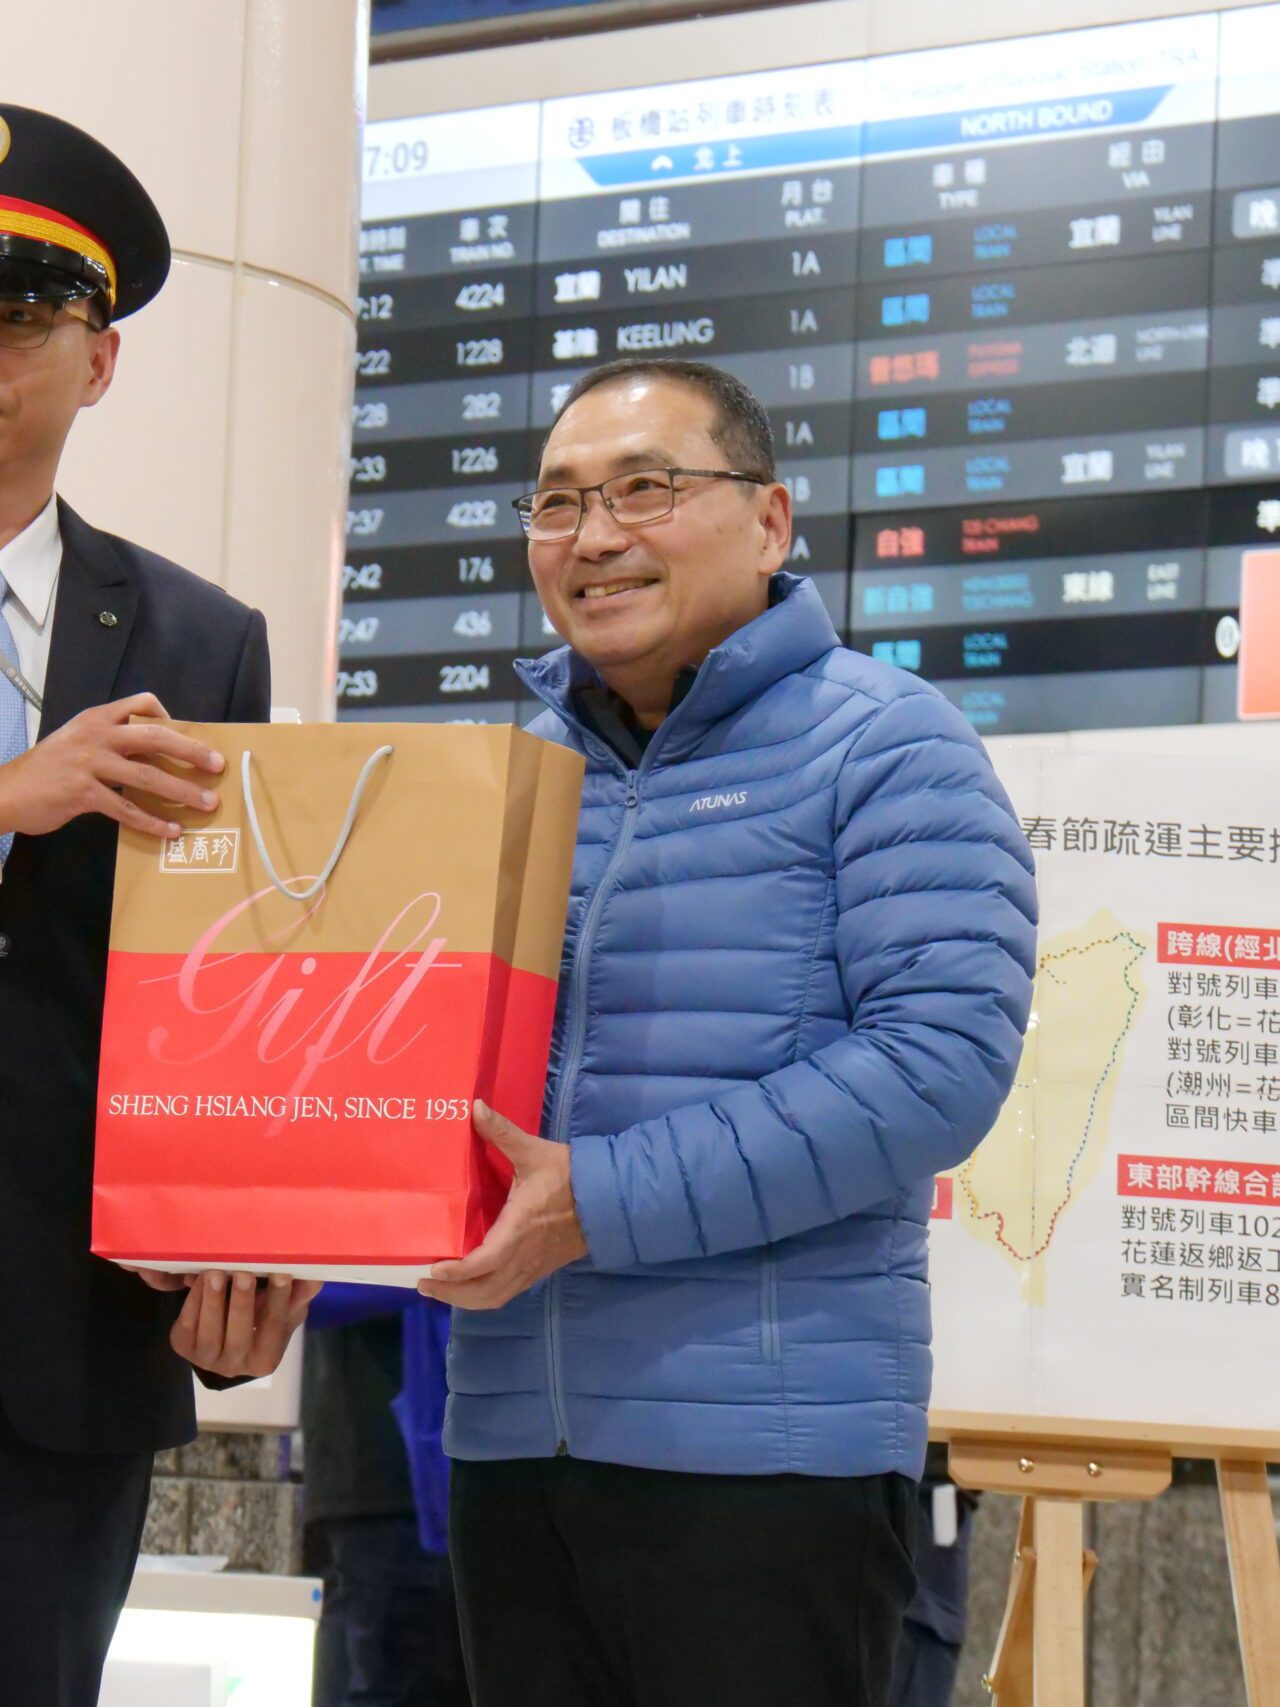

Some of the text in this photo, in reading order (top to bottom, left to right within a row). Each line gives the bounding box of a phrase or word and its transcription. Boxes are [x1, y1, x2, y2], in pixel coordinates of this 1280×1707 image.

[961, 99, 1113, 138] NORTH BOUND
[623, 250, 821, 293] YILAN 1A
[617, 308, 818, 351] KEELUNG 1A
[456, 337, 504, 367] 1228
[789, 364, 815, 390] 1B
[785, 420, 814, 446] 1A
[451, 446, 499, 474] 1226
[458, 555, 495, 583] 176
[438, 664, 490, 693] 2204
[688, 791, 748, 813] ATUNAS
[166, 833, 234, 867] 盛香珍
[1021, 816, 1280, 863] 春節疏運主要
[1168, 971, 1280, 1001] 對號列車
[138, 874, 463, 1138] Gift
[1167, 1036, 1280, 1067] 對號列車
[108, 1094, 470, 1122] SHENG HSIANG JEN, SINCE 1953
[1165, 1103, 1278, 1134] 區間快車
[1121, 1272, 1280, 1307] 實名制列車8
